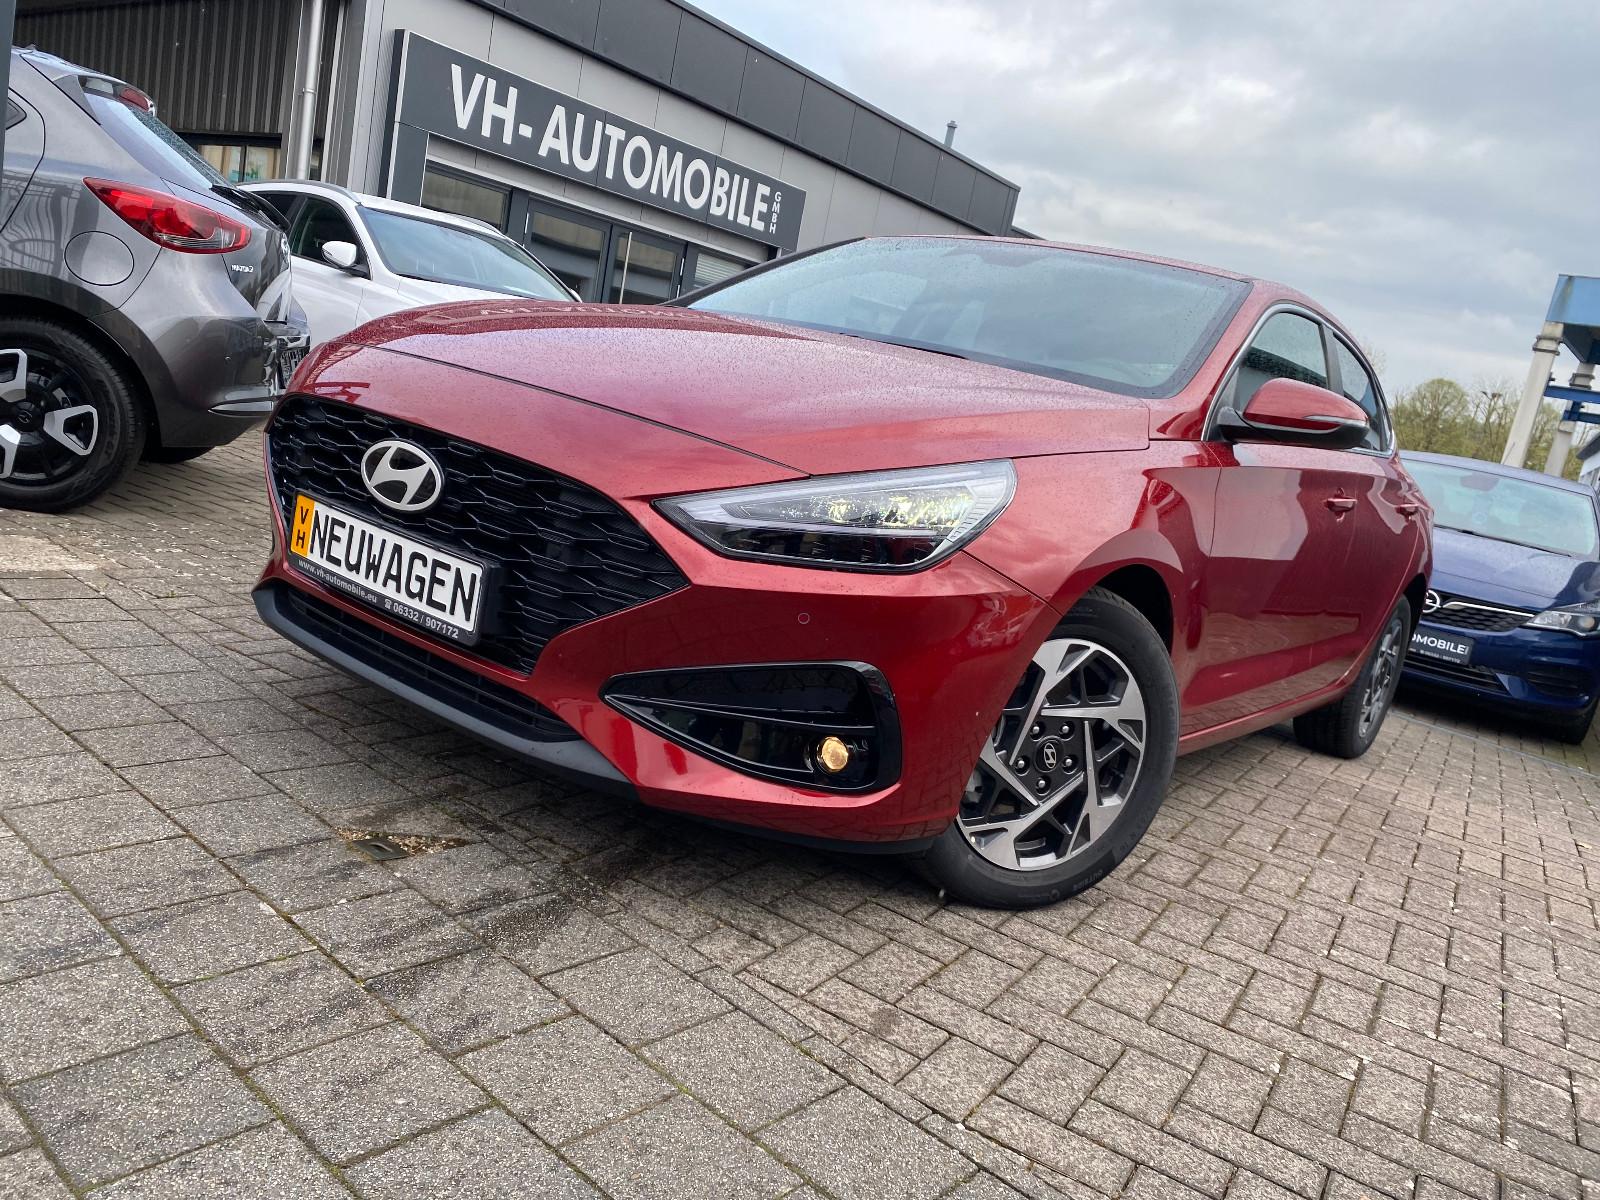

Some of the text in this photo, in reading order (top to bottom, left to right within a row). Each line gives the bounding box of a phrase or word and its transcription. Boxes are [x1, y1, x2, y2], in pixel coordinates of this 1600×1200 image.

[769, 191, 782, 234] GMBH
[298, 560, 377, 604] www.vh-automobile.eu
[393, 602, 419, 622] 06332
[425, 616, 459, 639] 907172
[311, 510, 477, 622] NEUWAGEN
